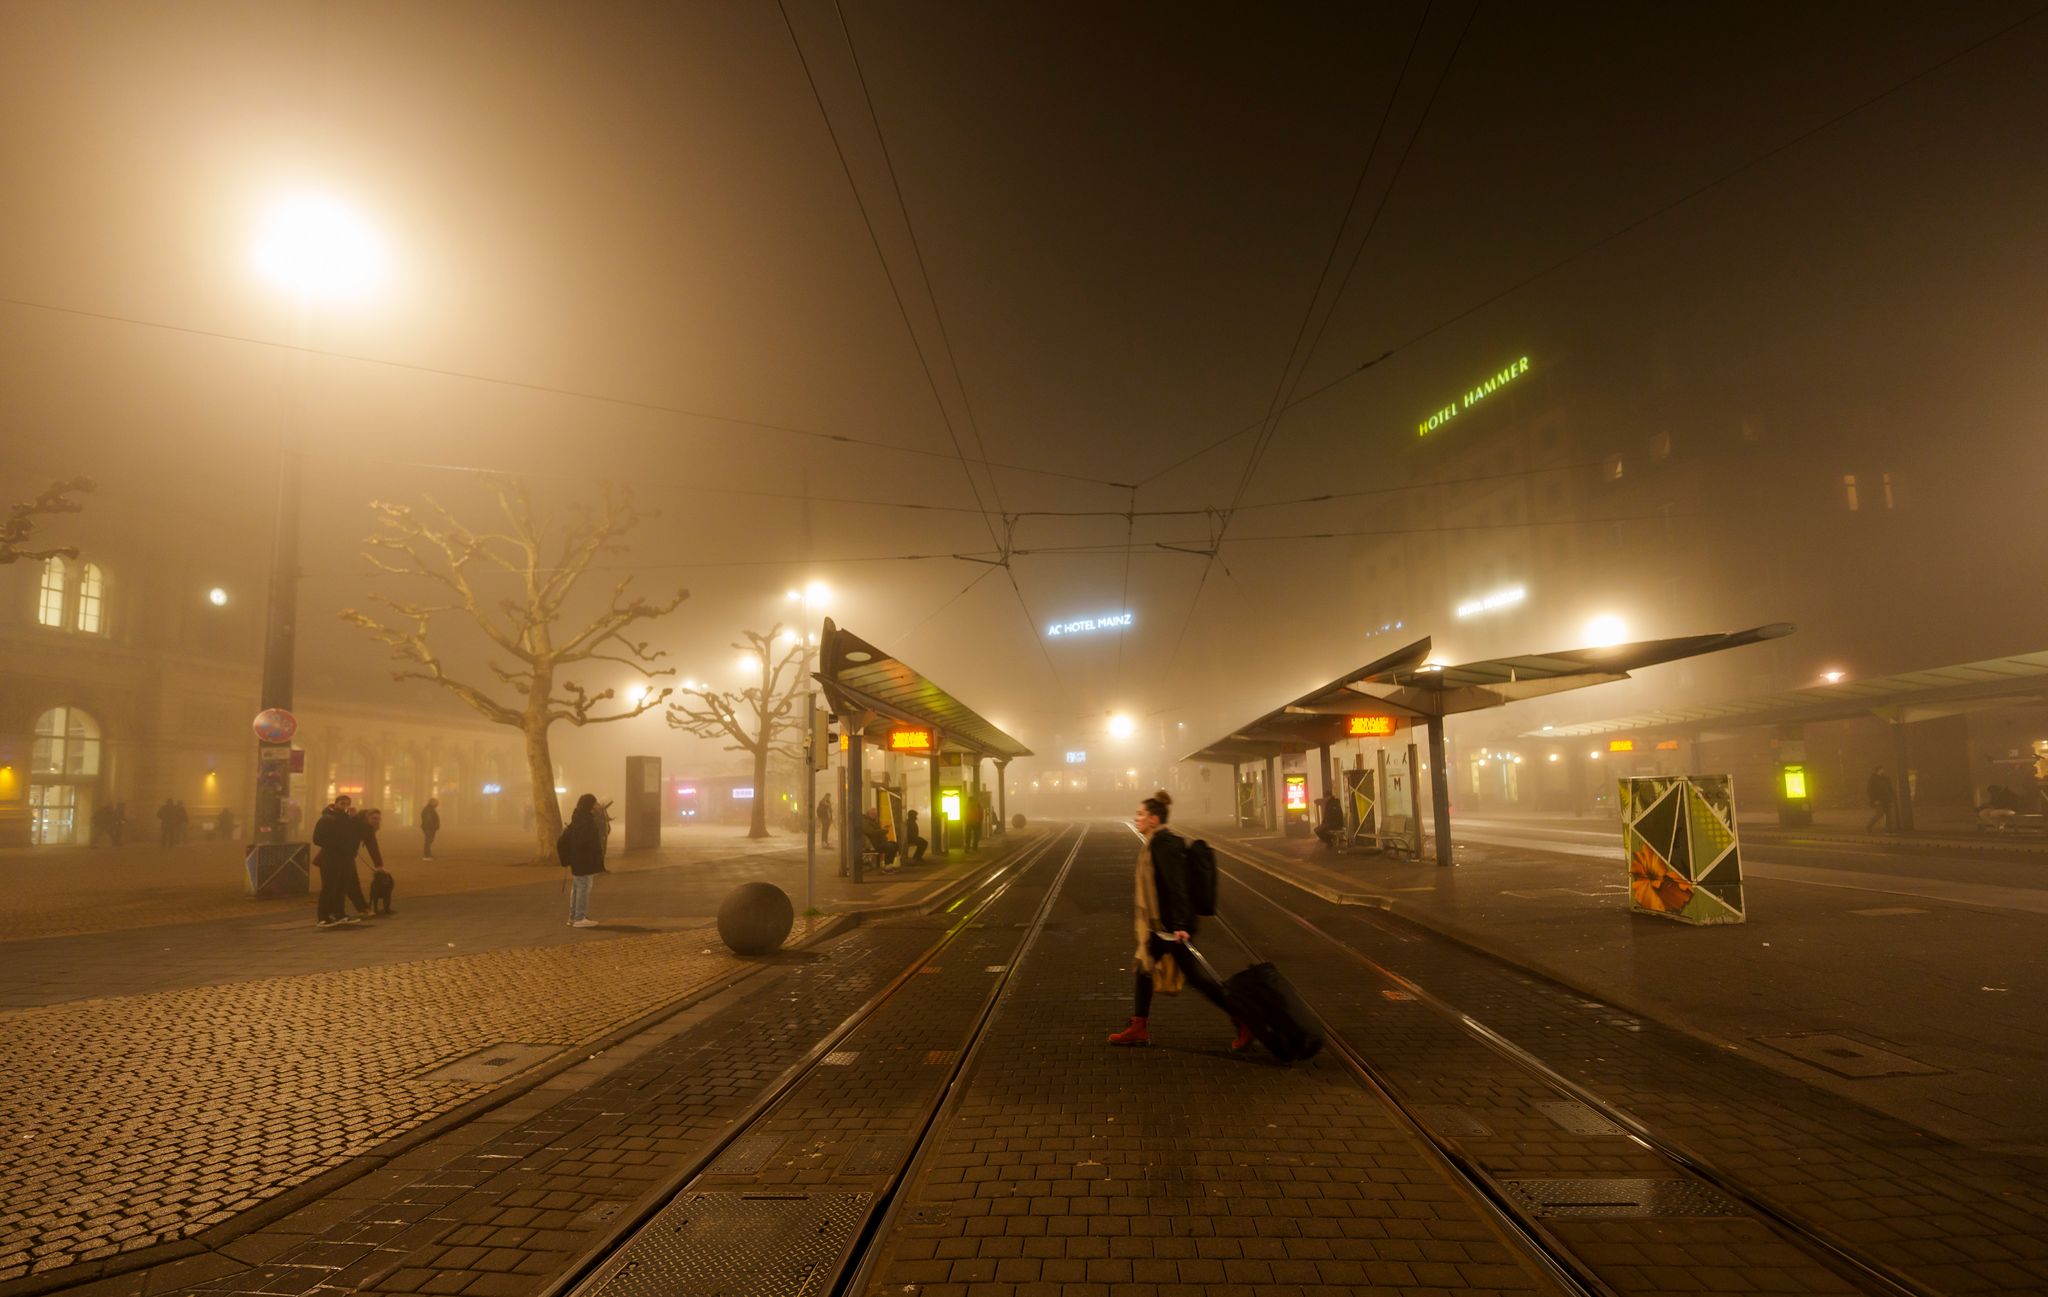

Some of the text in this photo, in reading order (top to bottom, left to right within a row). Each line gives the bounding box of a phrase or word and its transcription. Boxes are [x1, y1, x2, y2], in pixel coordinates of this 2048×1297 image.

[1419, 356, 1528, 436] HOTEL HAMMER
[1048, 614, 1131, 636] AC HOTEL MAINZ
